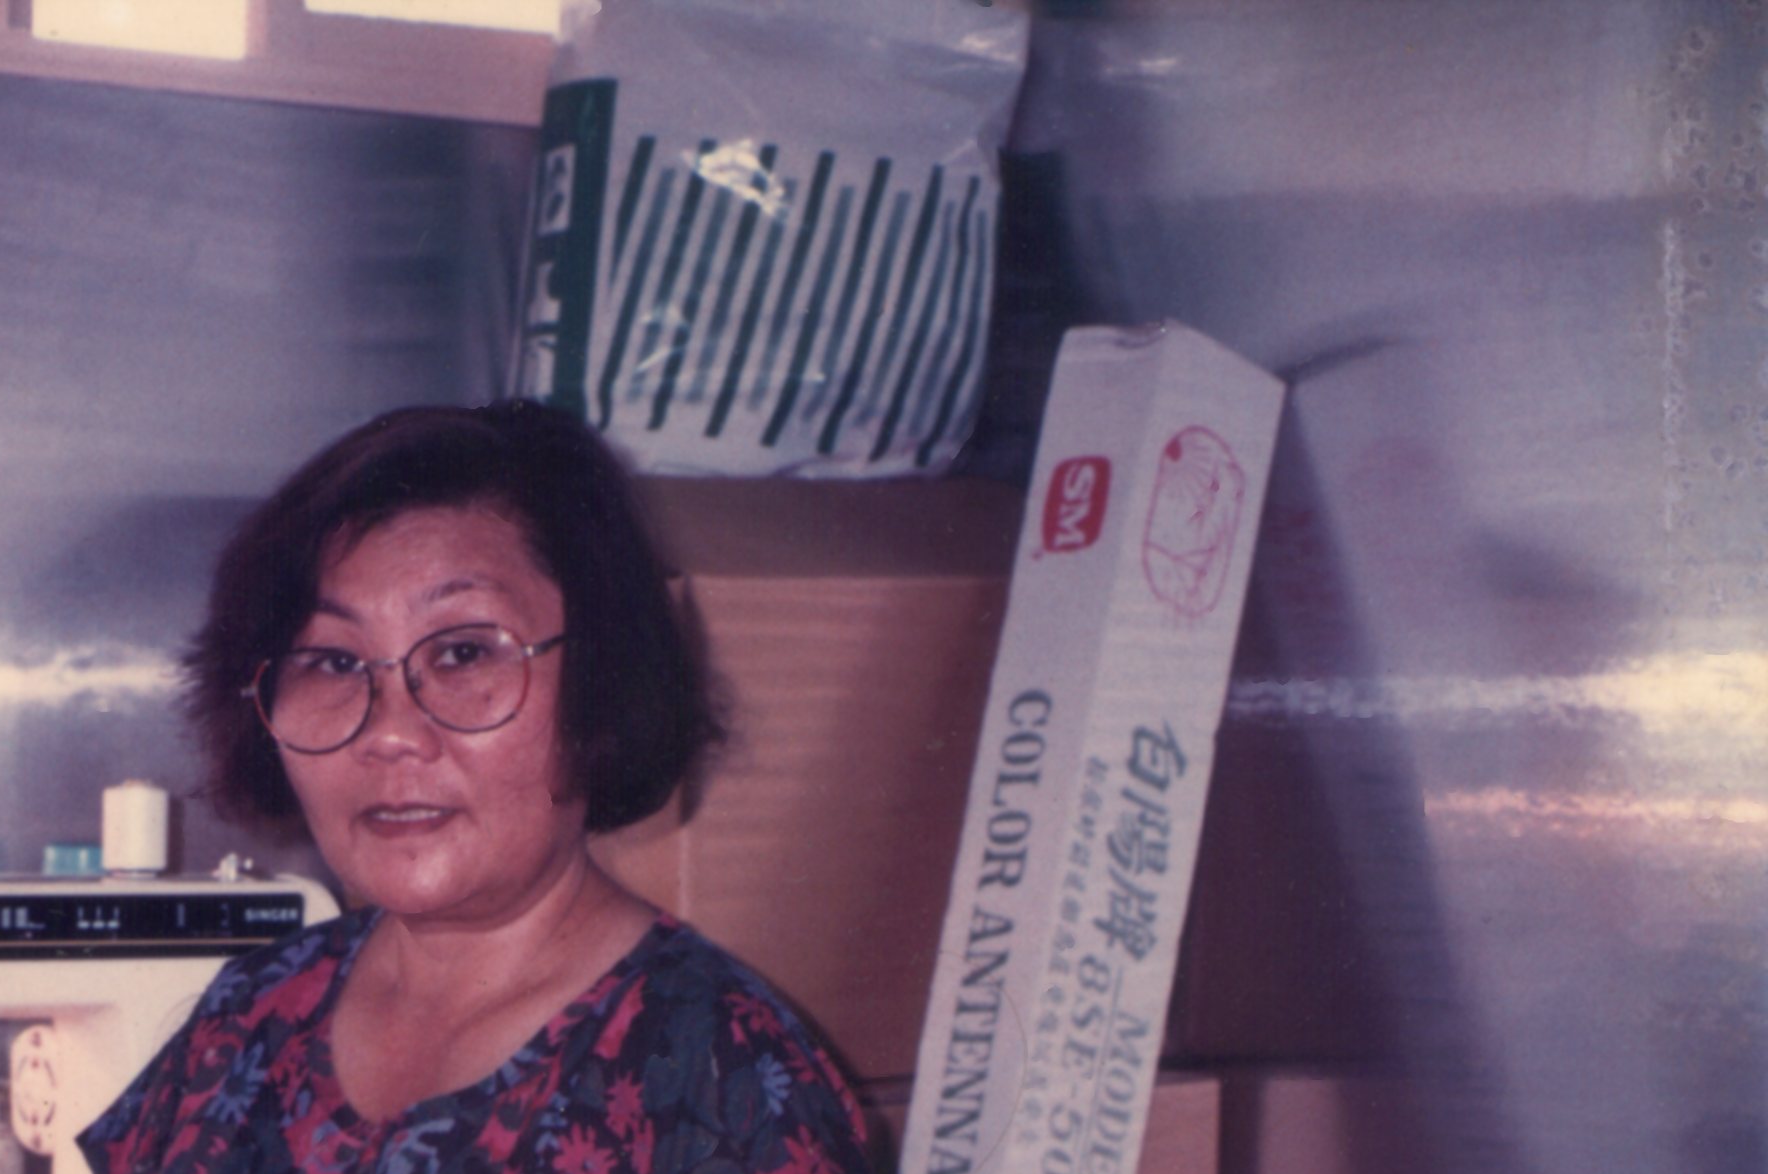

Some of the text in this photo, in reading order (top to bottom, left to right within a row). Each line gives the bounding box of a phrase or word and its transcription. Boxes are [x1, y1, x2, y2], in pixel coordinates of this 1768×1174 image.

[1052, 461, 1098, 548] SM
[976, 688, 1053, 891] COLOR
[1093, 718, 1188, 962] 白陽牌
[245, 908, 297, 921] SINGER
